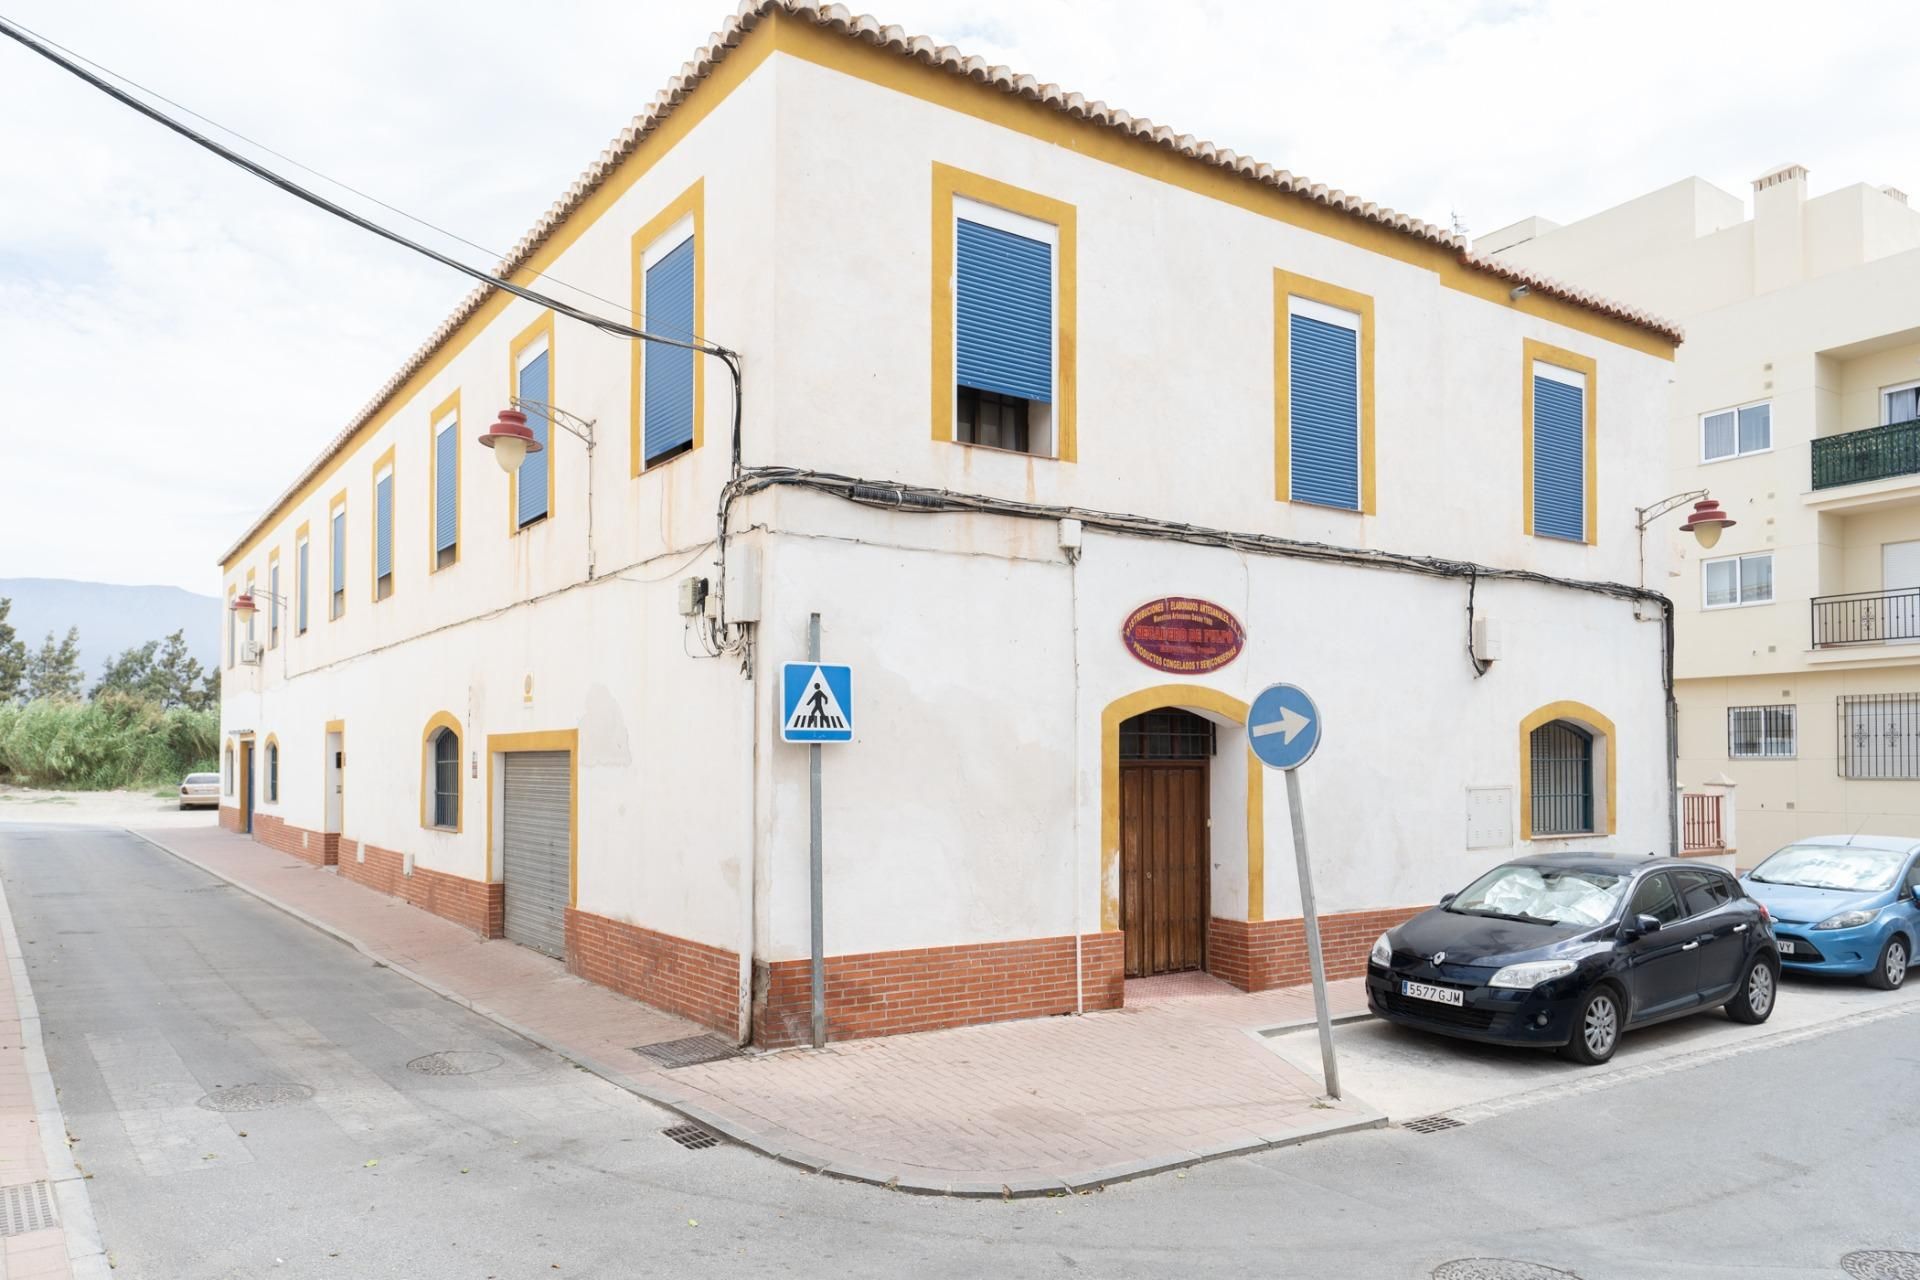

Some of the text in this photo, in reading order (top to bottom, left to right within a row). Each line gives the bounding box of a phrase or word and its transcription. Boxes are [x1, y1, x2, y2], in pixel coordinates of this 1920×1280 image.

[1133, 642, 1163, 665] PRODUCTOS
[1162, 659, 1195, 671] CONGELADOS
[1410, 984, 1461, 1003] 5577 GJM
